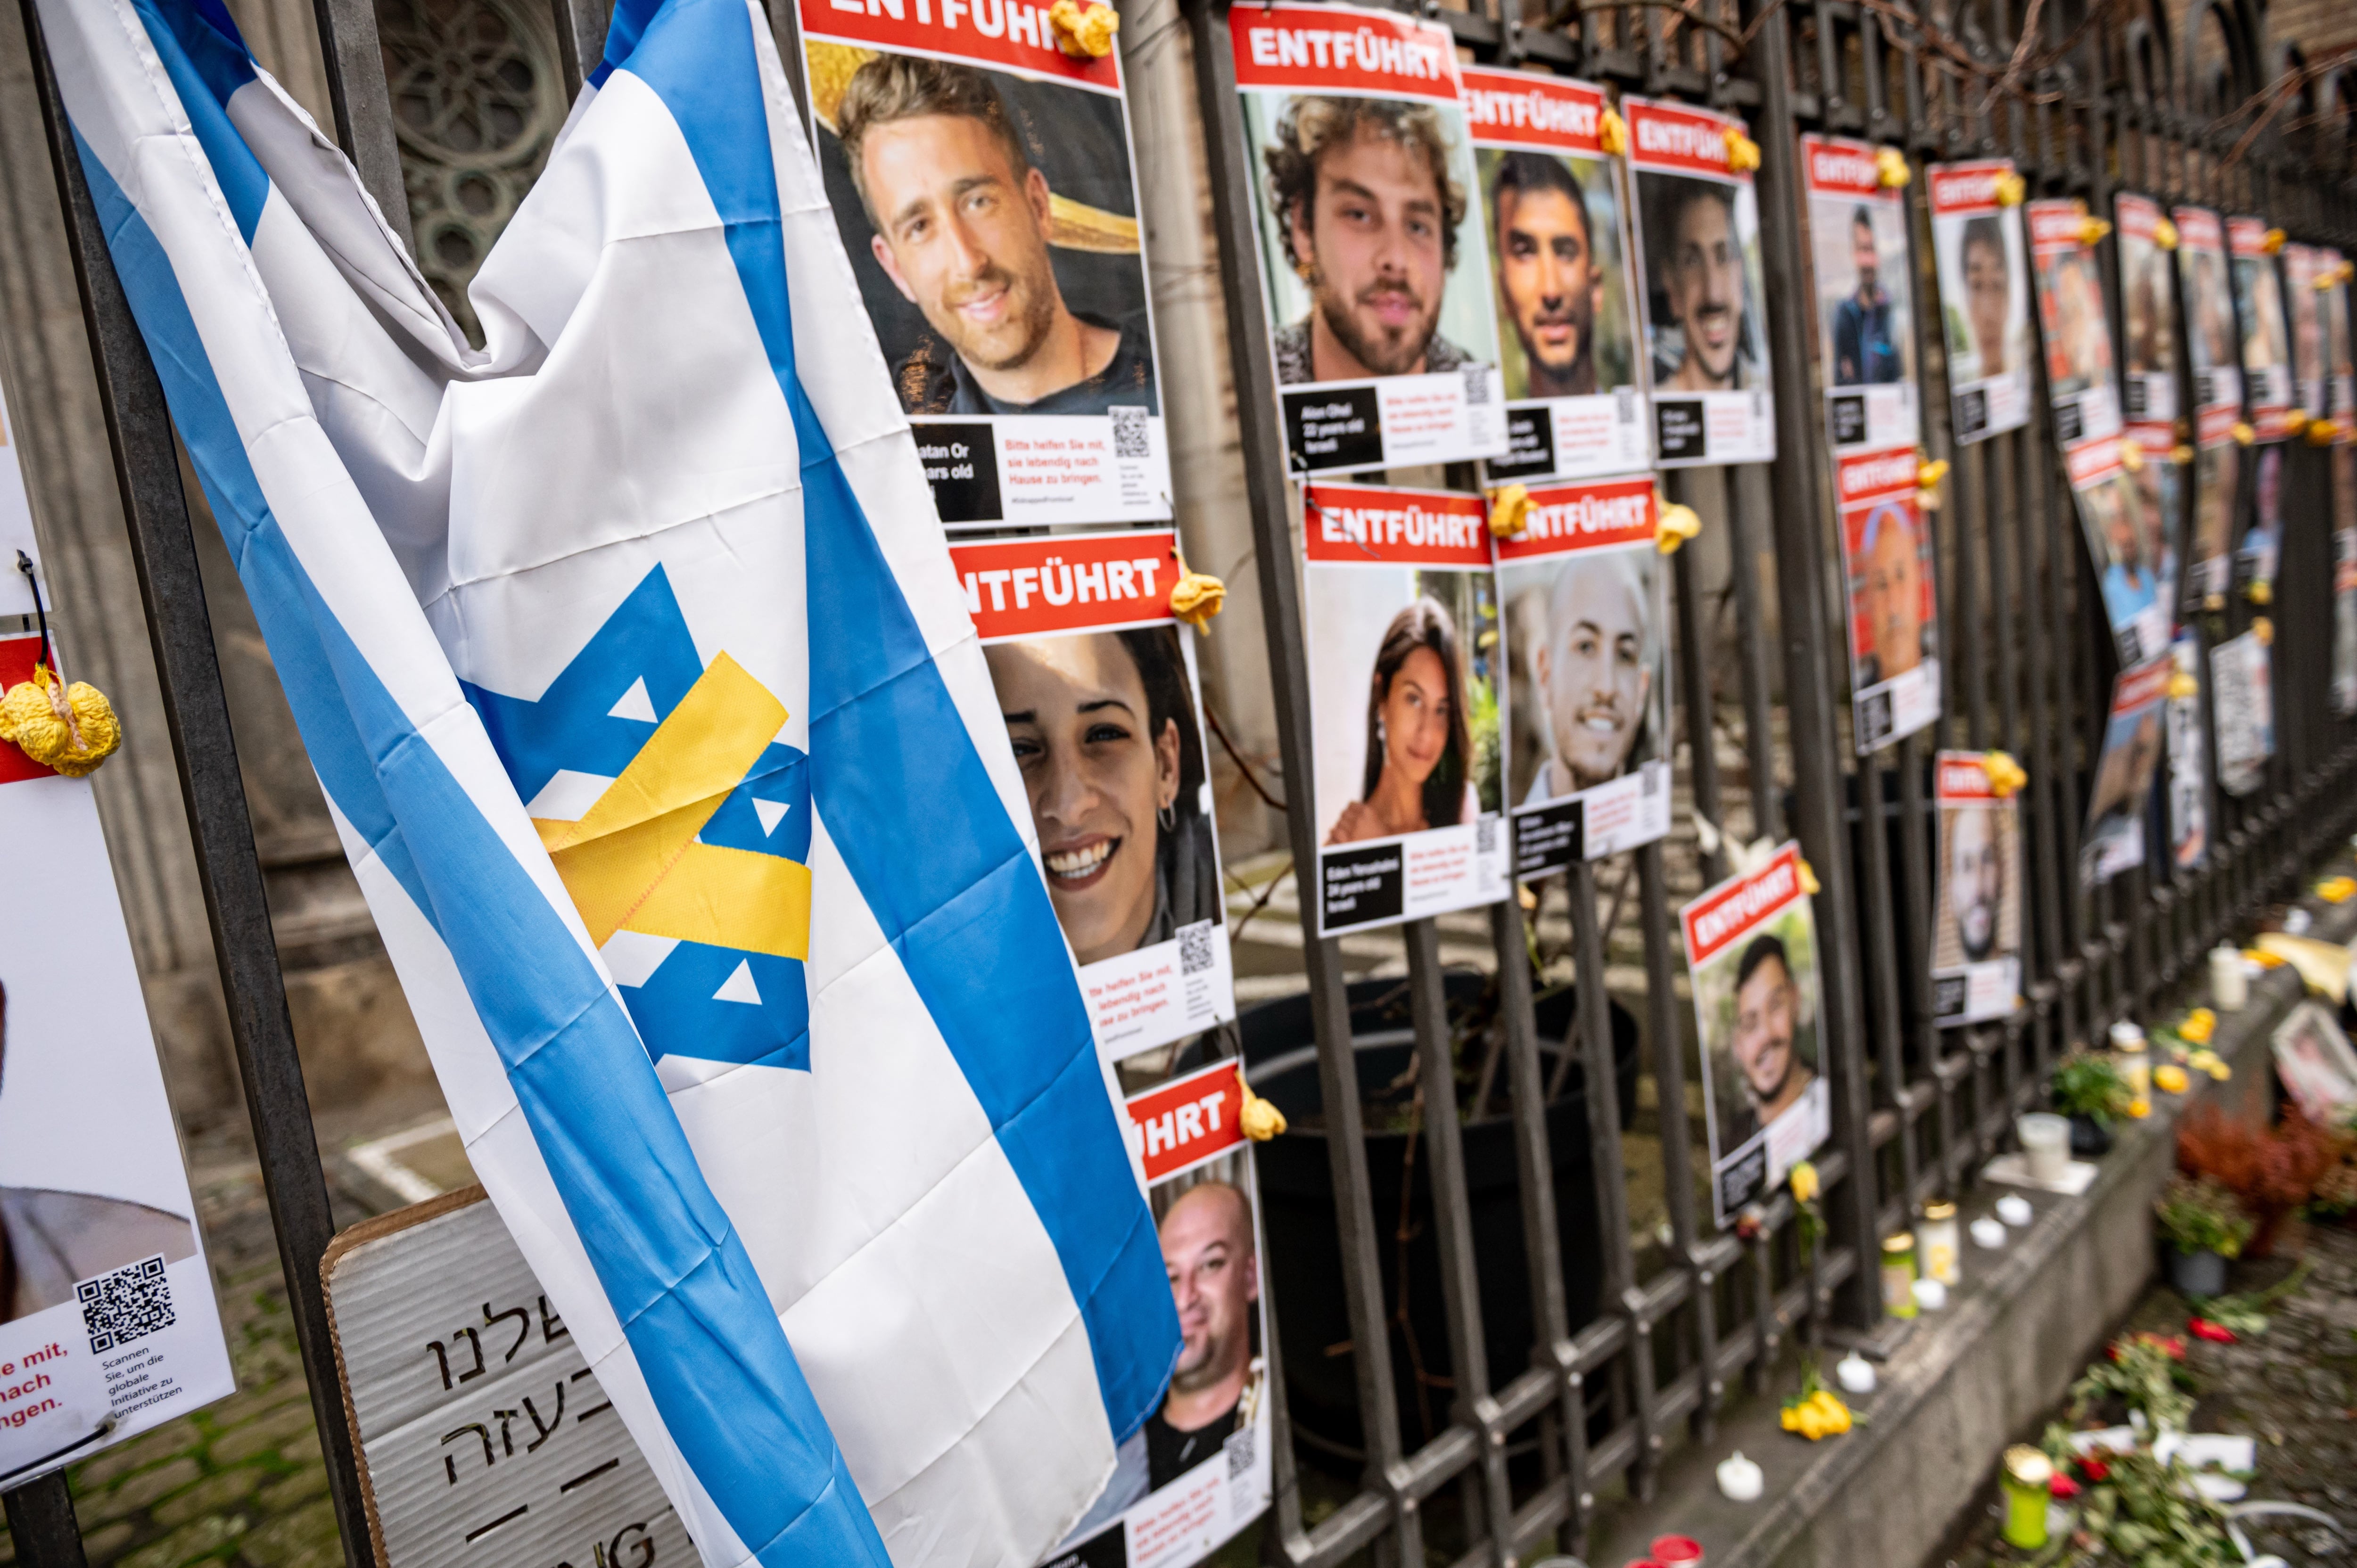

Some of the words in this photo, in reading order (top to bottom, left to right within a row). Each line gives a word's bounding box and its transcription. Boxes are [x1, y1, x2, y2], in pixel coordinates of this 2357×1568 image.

[1249, 26, 1440, 81] ENTFÜHRT
[1461, 88, 1598, 137] ENTFÜHRT
[950, 442, 970, 459] Or
[951, 463, 974, 480] old
[1321, 505, 1483, 549] ENTFÜHRT
[1510, 494, 1648, 543] NTFÜHRT
[23, 1342, 67, 1368] mit,
[102, 1347, 149, 1370] Scannen
[105, 1371, 124, 1382] Sie,
[127, 1363, 145, 1374] um
[147, 1355, 164, 1365] die
[108, 1374, 149, 1396] globale
[111, 1383, 158, 1407] Initiative
[160, 1378, 173, 1387] zu
[114, 1387, 182, 1419] unterstützen
